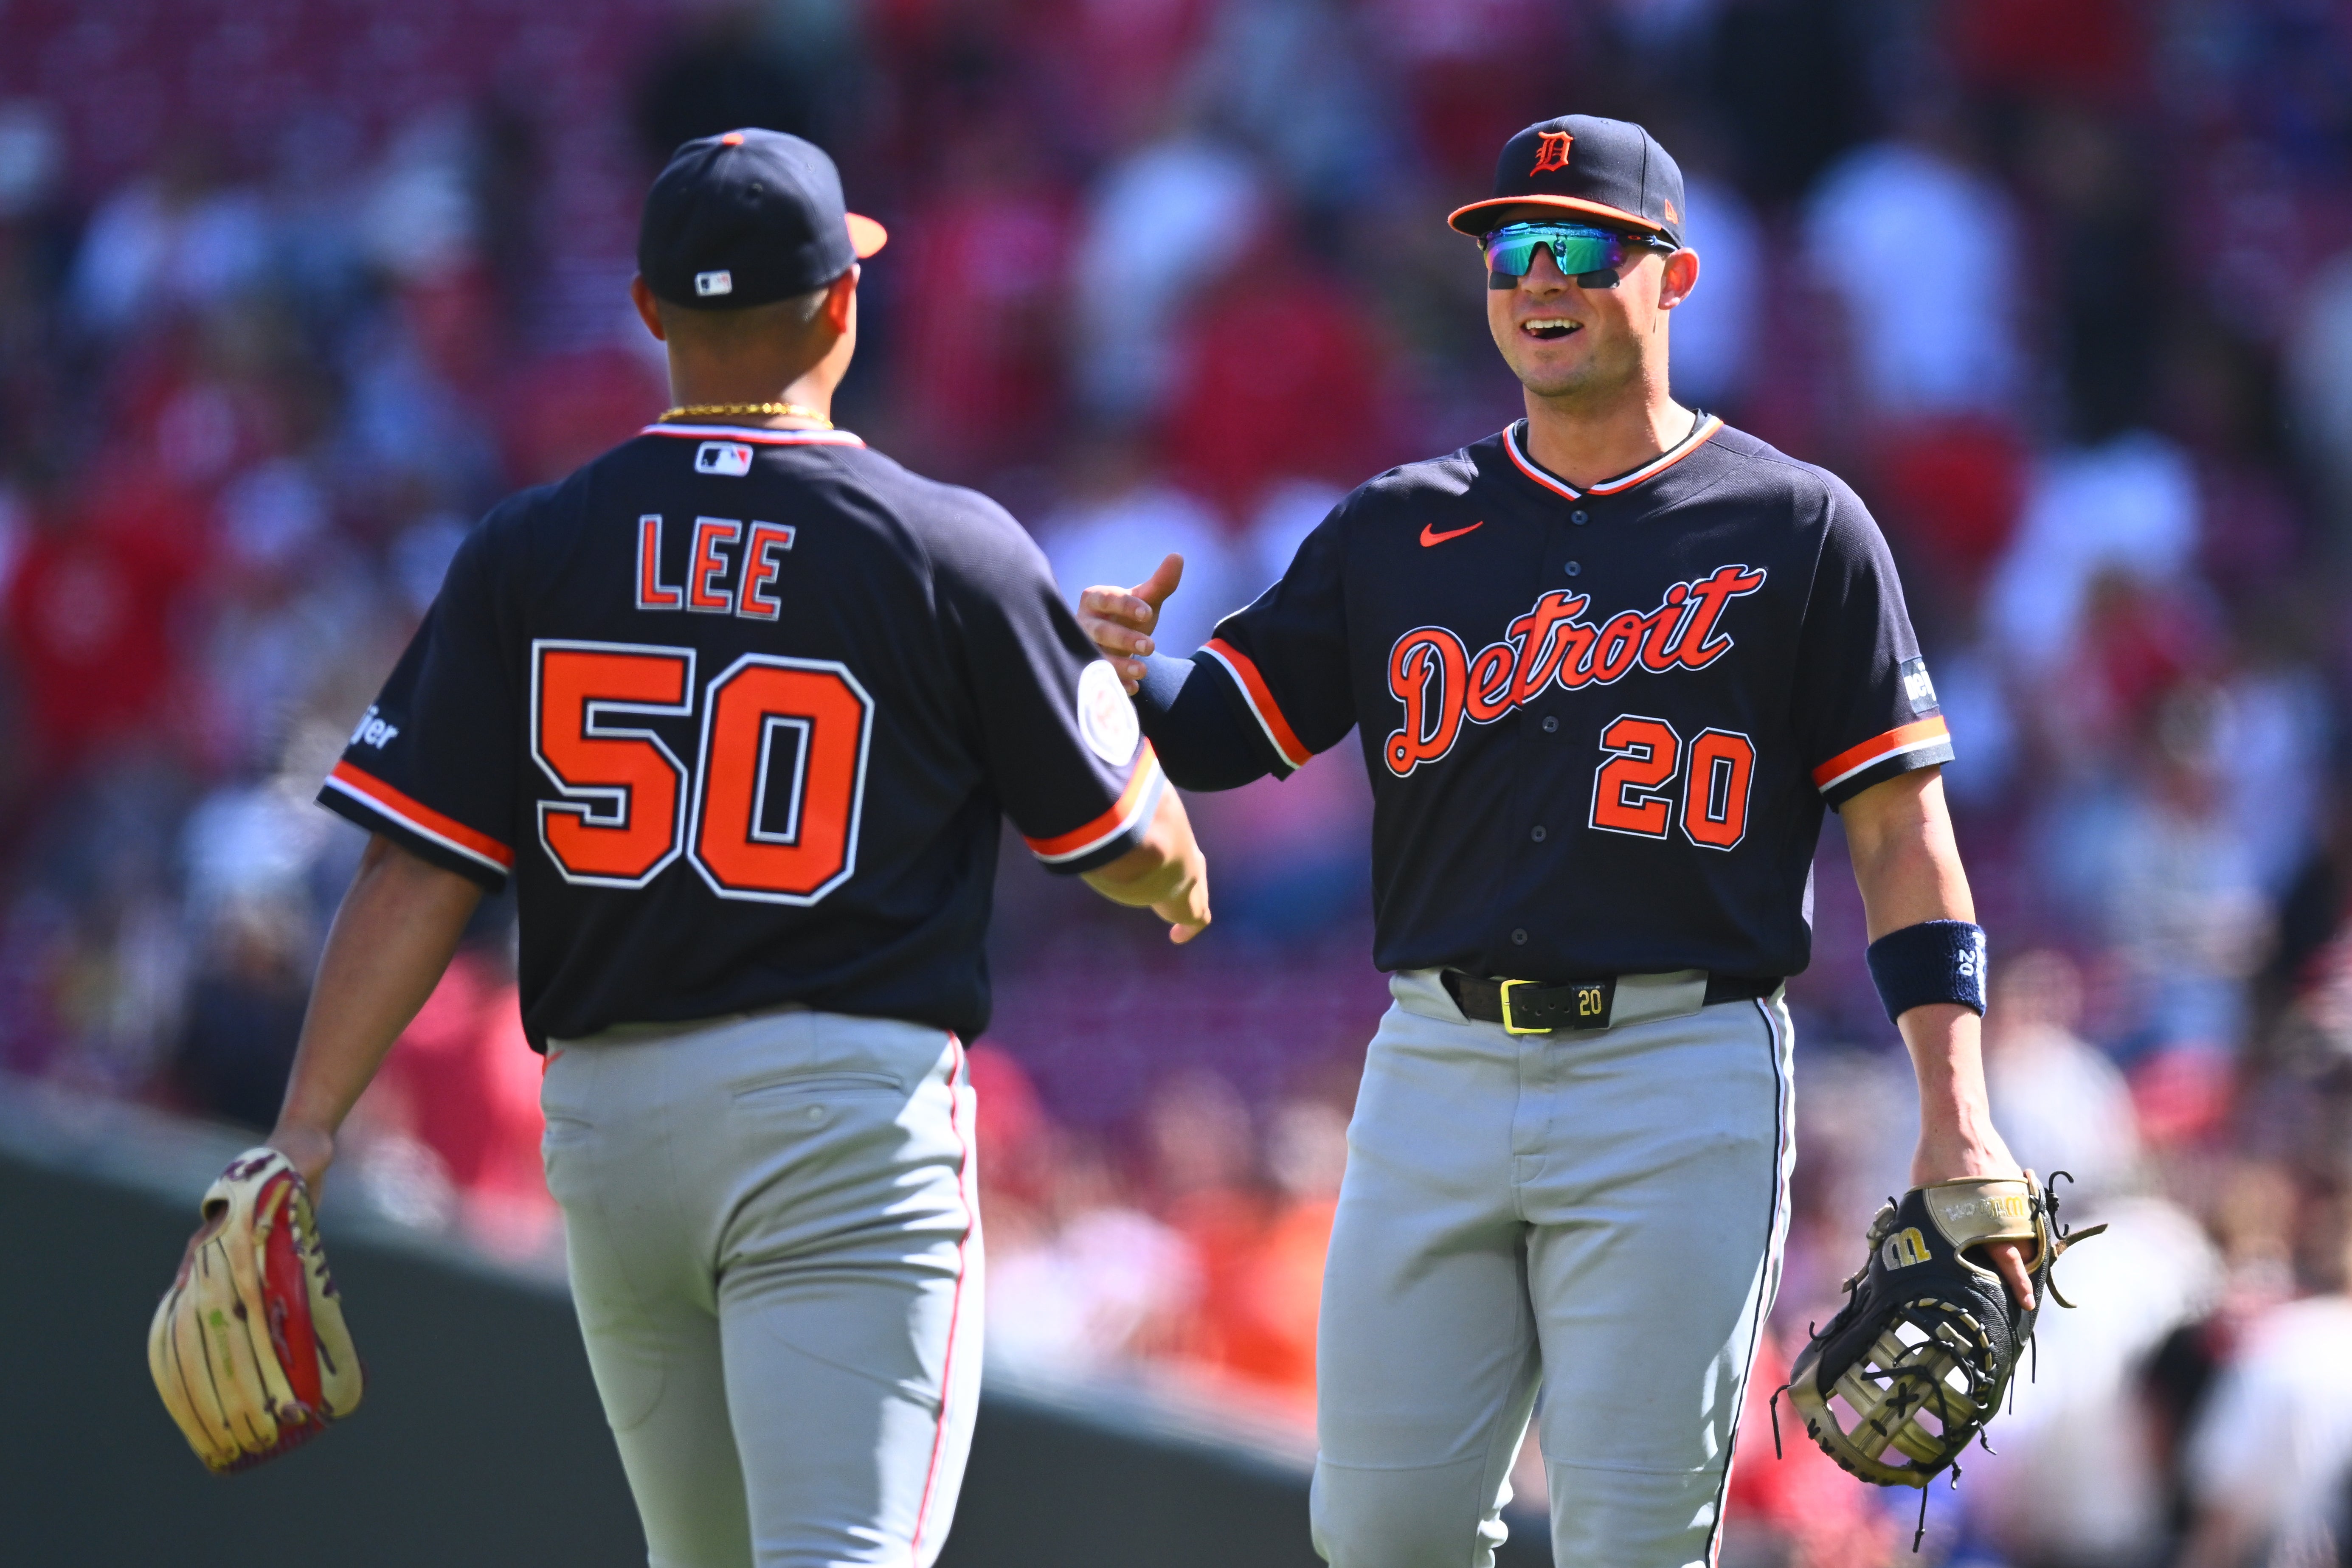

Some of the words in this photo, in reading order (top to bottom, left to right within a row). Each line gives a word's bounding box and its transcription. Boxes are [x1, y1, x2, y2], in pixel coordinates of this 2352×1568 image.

[1530, 131, 1573, 177] D
[636, 514, 795, 621] LEE
[1384, 565, 1766, 777] Detroit
[350, 705, 399, 750] jer
[532, 638, 874, 907] 50
[1589, 714, 1756, 851] 20
[1959, 950, 1975, 976] 20
[1578, 989, 1602, 1016] 20
